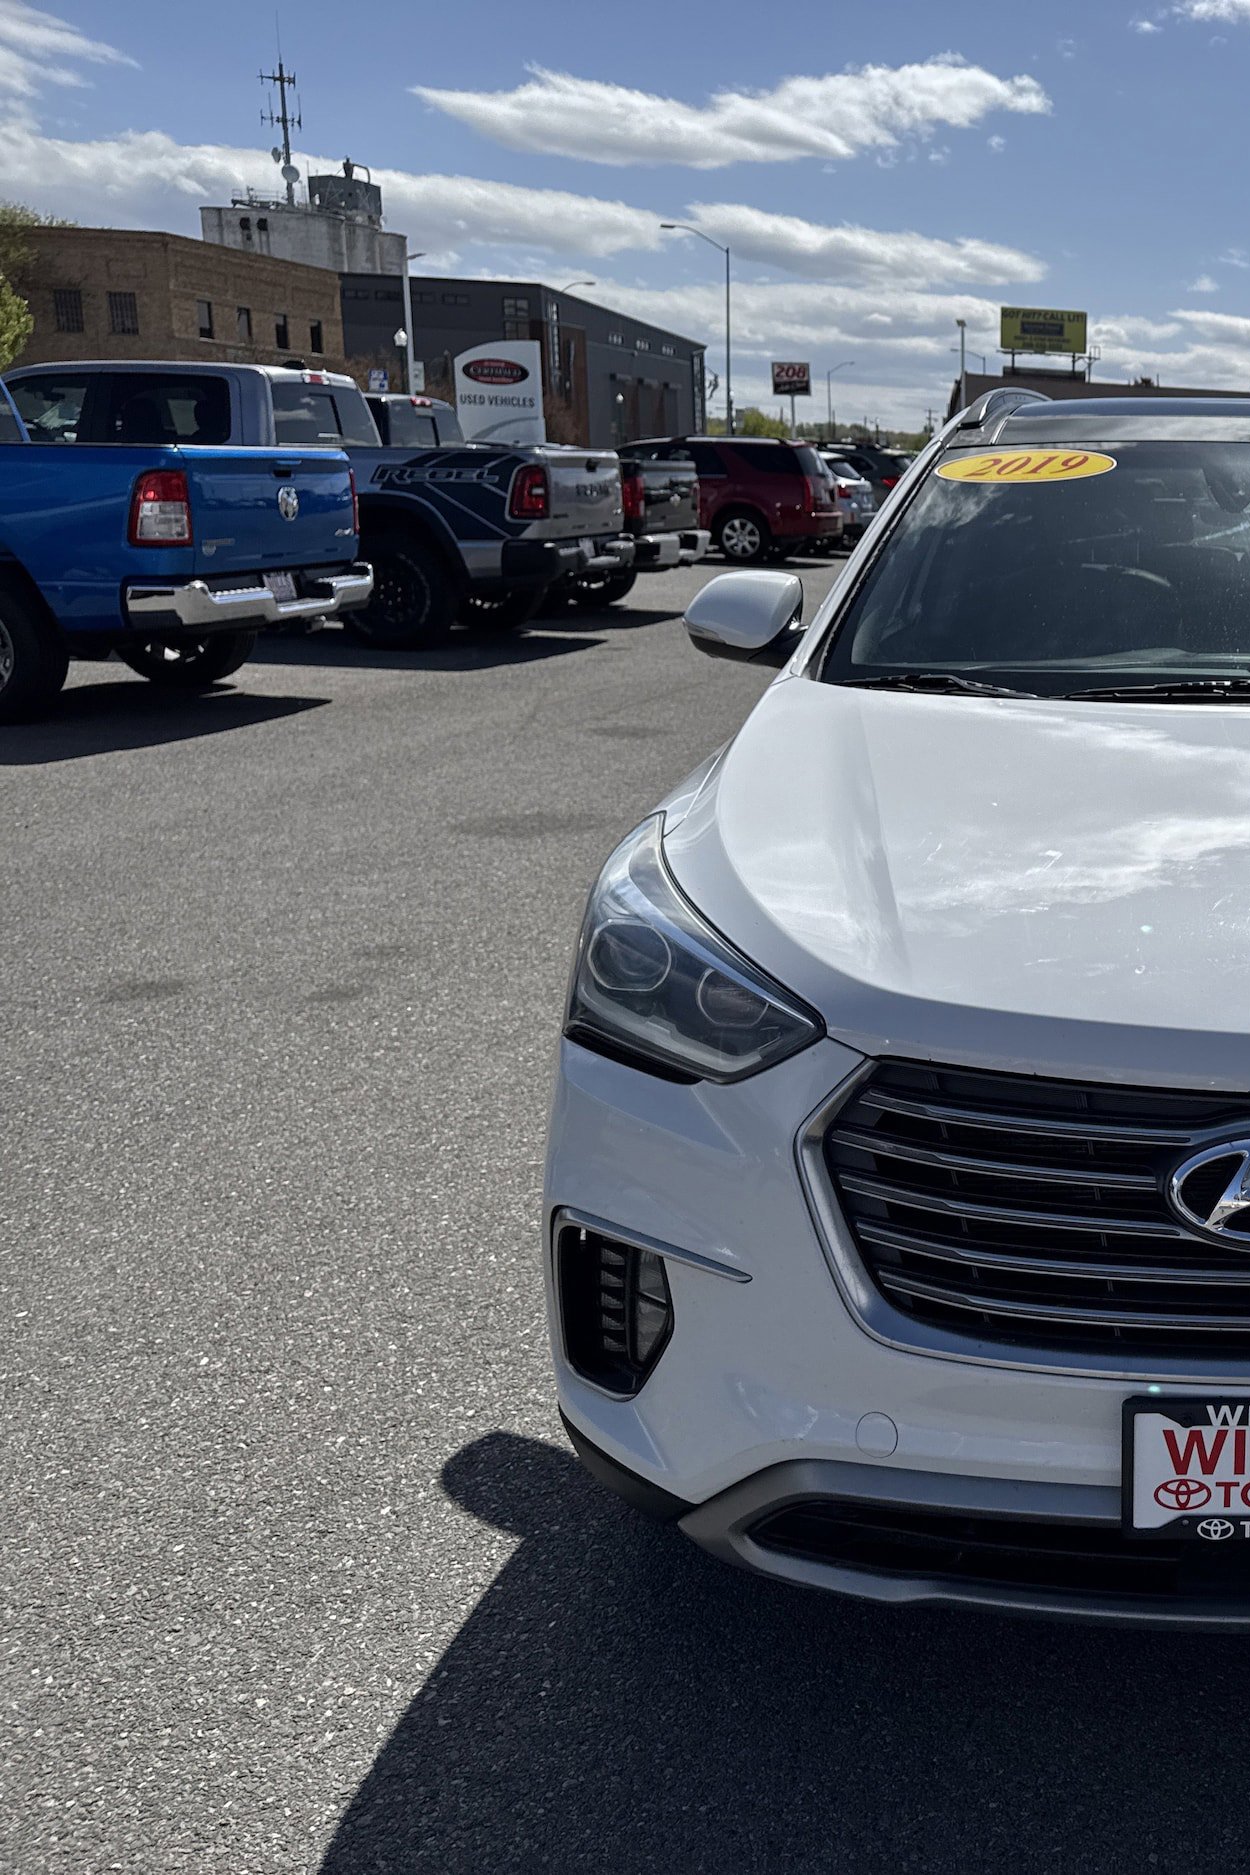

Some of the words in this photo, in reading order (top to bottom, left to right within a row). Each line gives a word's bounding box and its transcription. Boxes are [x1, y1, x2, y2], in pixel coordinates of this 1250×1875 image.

[775, 365, 807, 378] 208
[460, 393, 486, 406] USED
[487, 394, 536, 409] VEHICLES
[963, 455, 1089, 477] 2019
